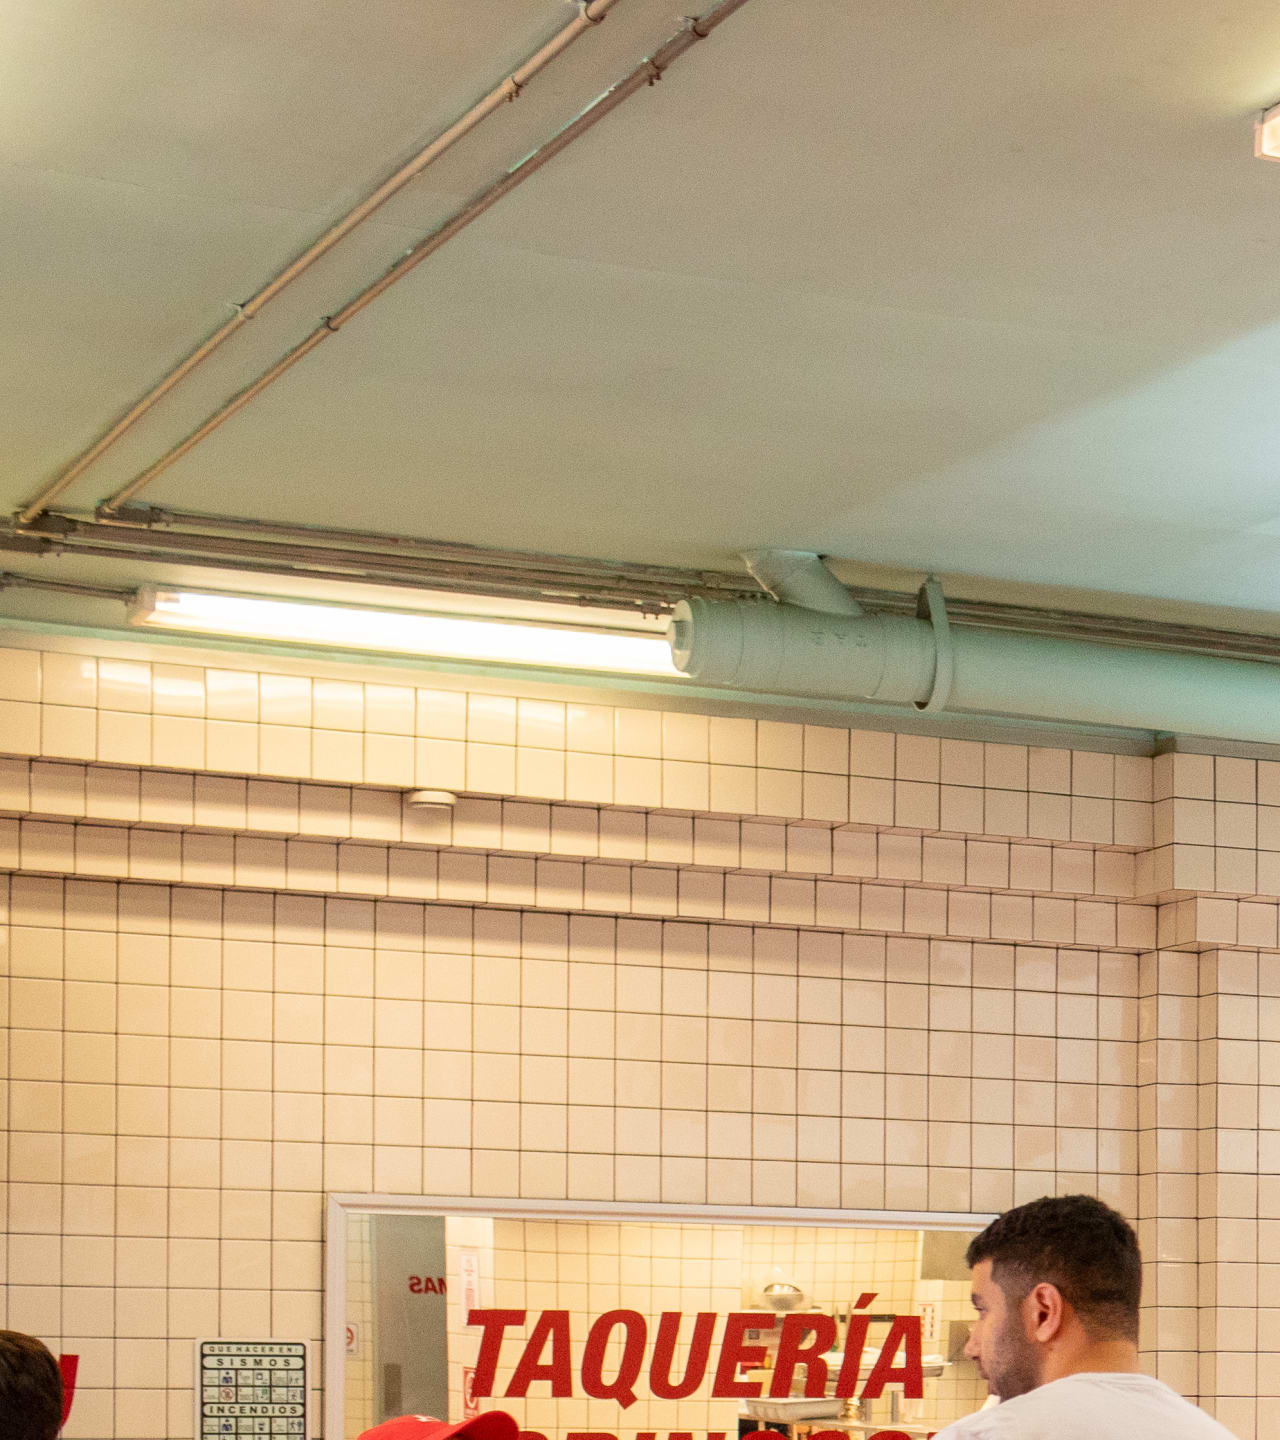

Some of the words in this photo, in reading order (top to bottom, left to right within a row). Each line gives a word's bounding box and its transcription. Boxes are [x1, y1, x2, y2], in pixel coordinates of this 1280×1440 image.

[466, 1292, 924, 1410] TAQUERÍA
[216, 1358, 291, 1367] SISMOS
[209, 1405, 298, 1415] INCENDIOS
